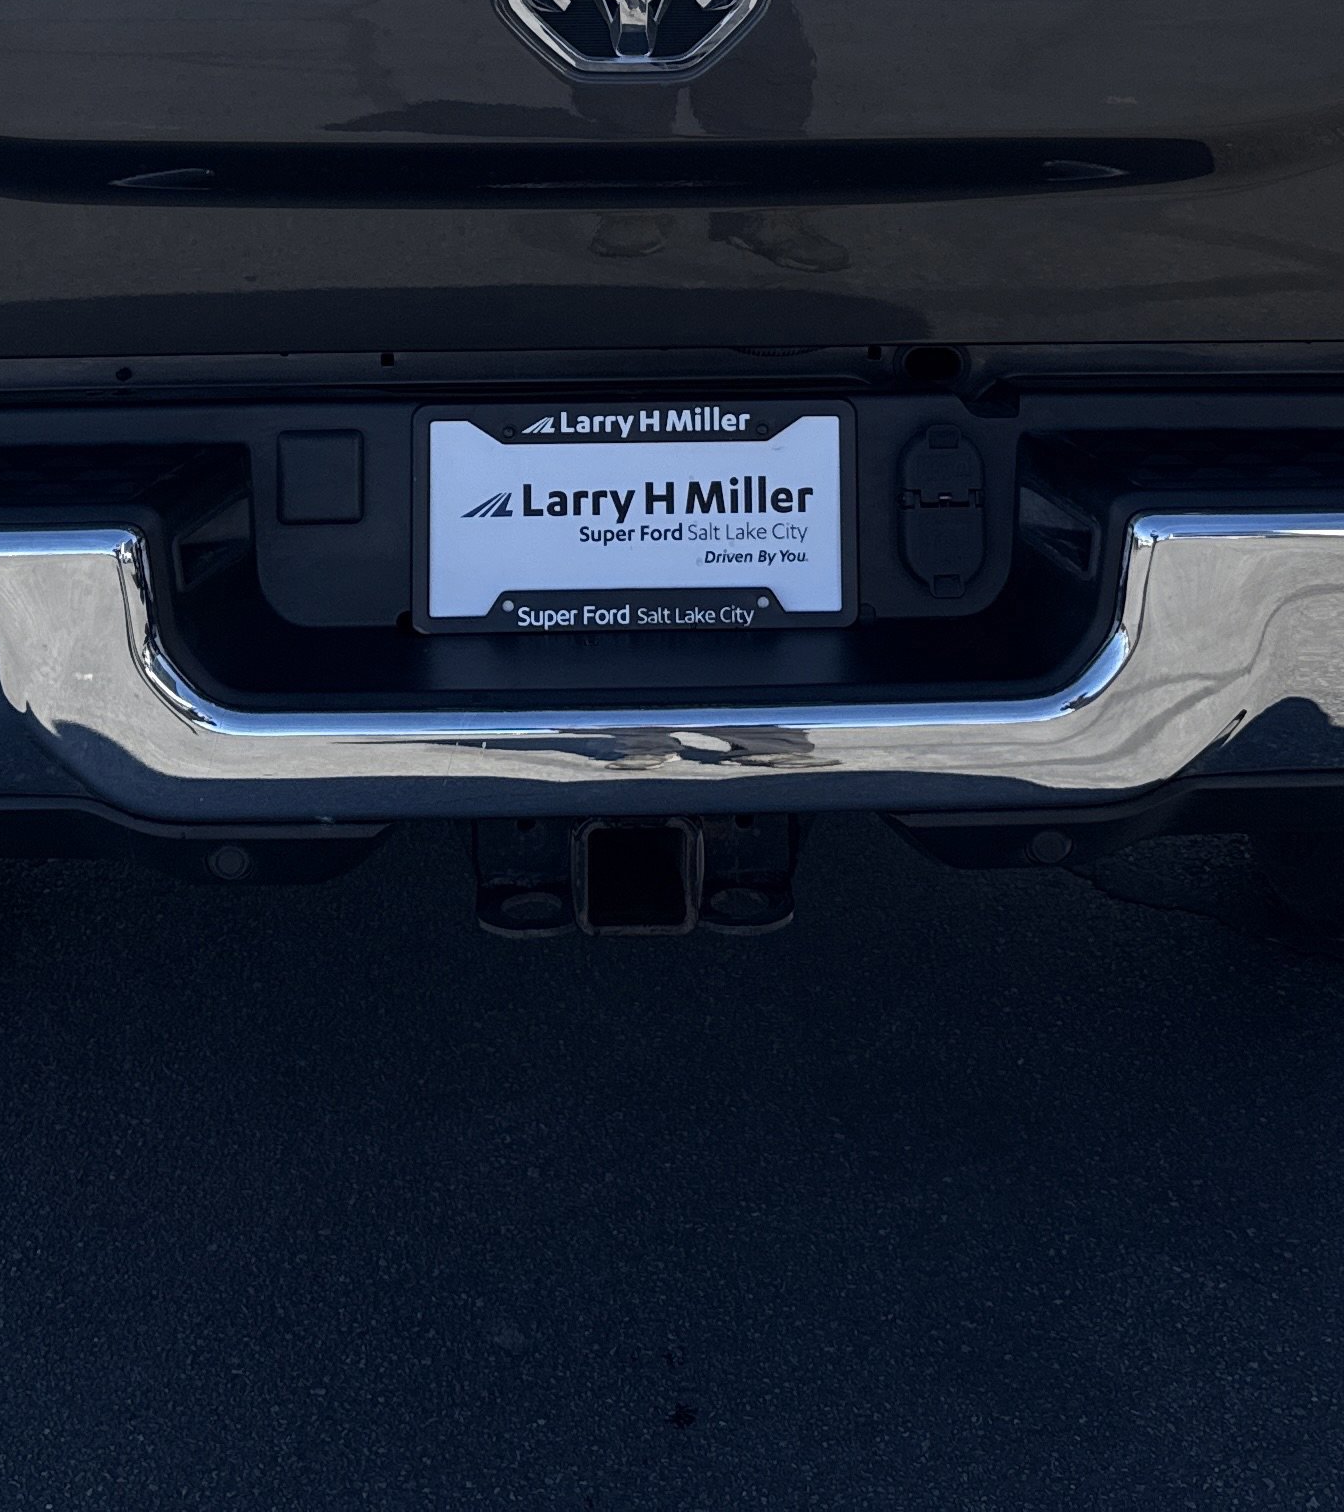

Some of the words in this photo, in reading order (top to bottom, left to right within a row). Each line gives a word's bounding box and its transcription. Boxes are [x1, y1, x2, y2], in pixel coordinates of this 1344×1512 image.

[560, 410, 635, 438] Larry
[640, 410, 660, 432] H
[666, 407, 751, 432] Miller
[522, 483, 636, 524] Larry
[645, 482, 675, 515] H
[685, 476, 814, 515] Miller
[579, 526, 635, 546] Super
[640, 523, 683, 542] Ford
[687, 522, 720, 541] Salt
[726, 522, 767, 540] Lake
[772, 522, 808, 543] City
[704, 549, 753, 564] Driven
[758, 550, 777, 566] By
[517, 606, 578, 631] Super
[583, 604, 630, 625] Ford
[637, 607, 671, 625] Salt
[675, 606, 716, 624] Lake
[720, 605, 754, 627] City
